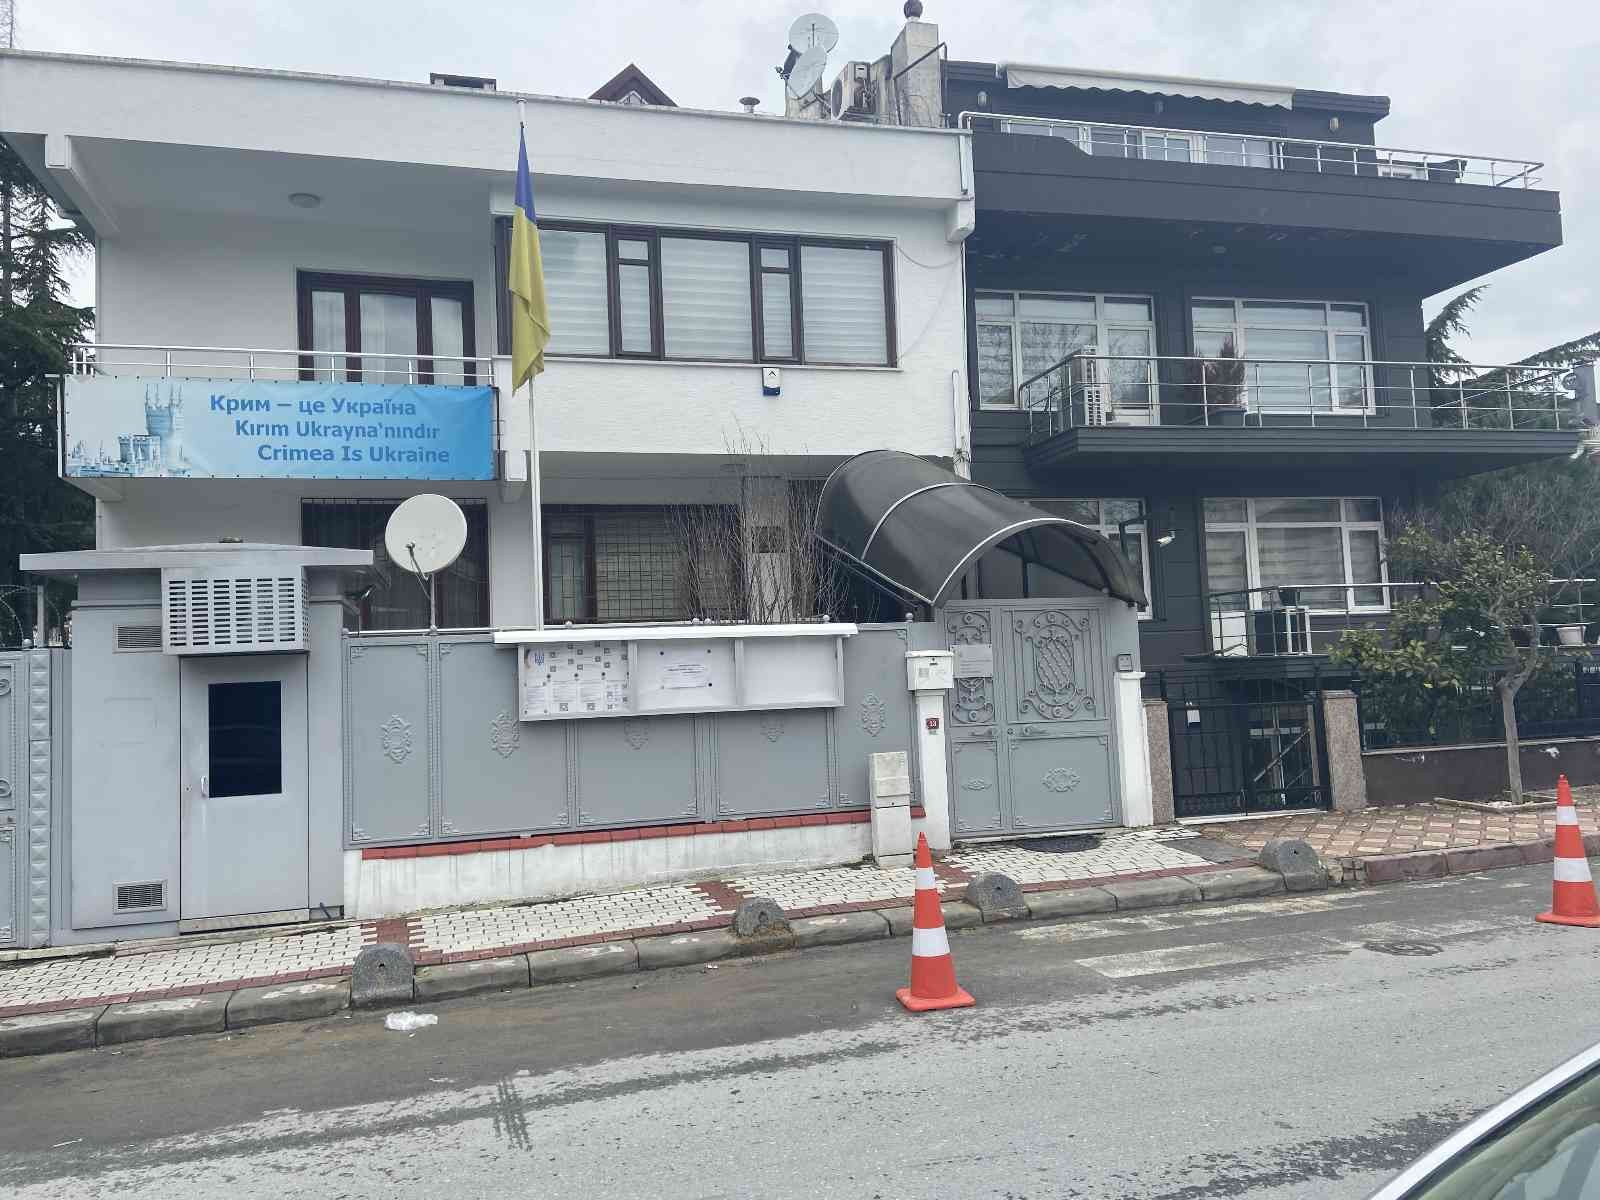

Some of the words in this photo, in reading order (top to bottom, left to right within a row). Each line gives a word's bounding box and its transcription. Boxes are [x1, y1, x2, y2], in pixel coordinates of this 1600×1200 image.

[210, 394, 271, 415] Крим
[298, 399, 326, 415] це
[331, 398, 417, 417] Україна
[235, 419, 289, 436] Kırım
[257, 444, 335, 461] Crimea
[342, 445, 363, 462] Is
[369, 445, 450, 463] Ukraine
